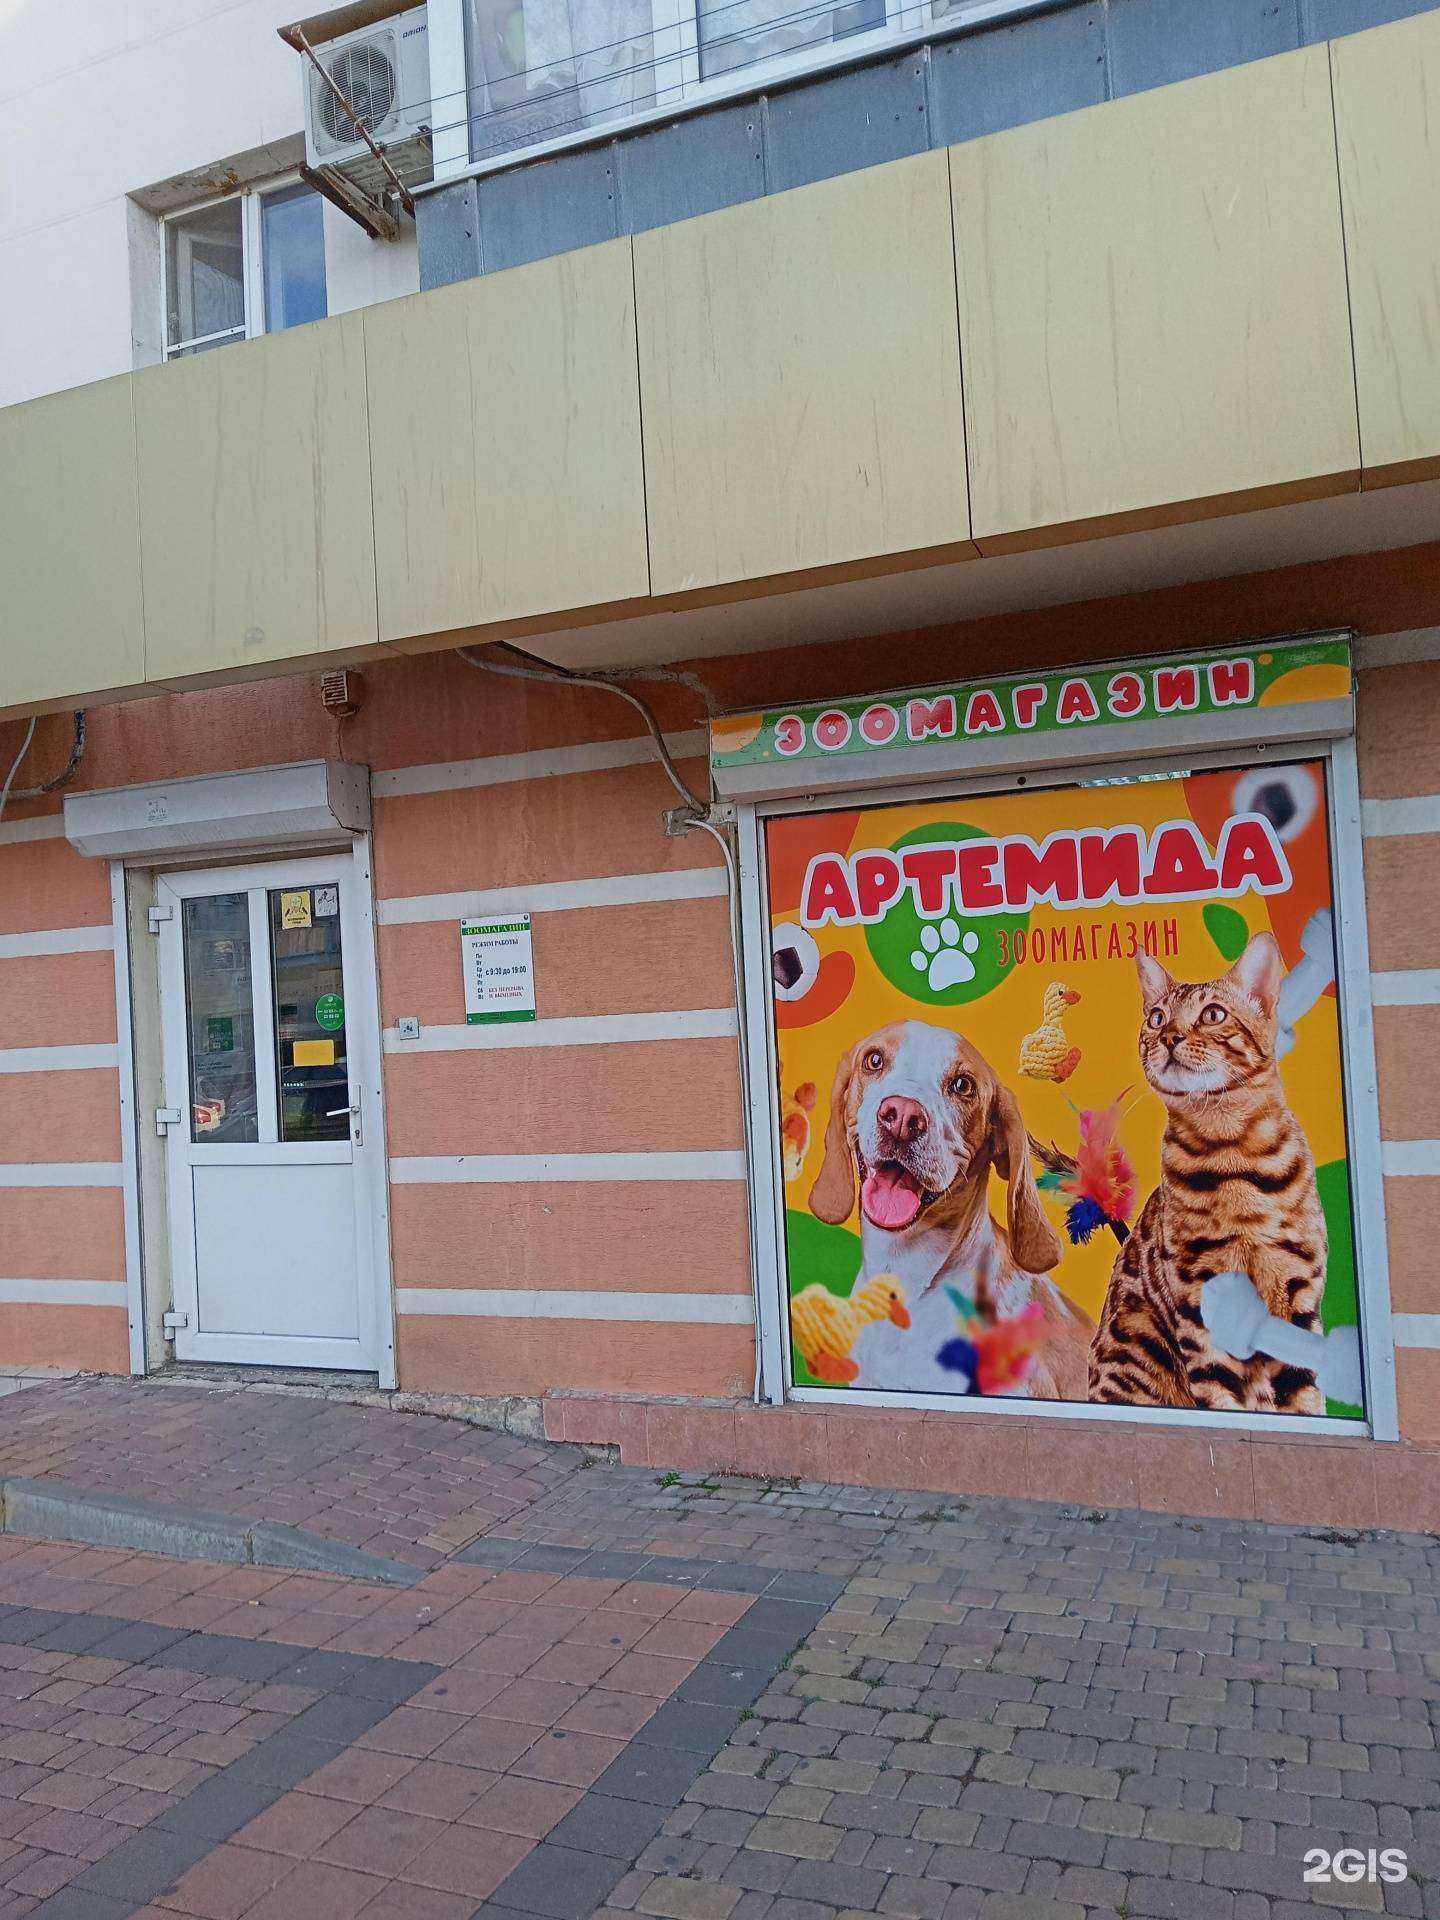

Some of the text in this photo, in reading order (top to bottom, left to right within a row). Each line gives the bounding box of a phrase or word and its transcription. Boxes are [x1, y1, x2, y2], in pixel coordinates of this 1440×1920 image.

[775, 657, 1255, 756] ЗООМАГАЗИН
[800, 811, 1294, 929] АРТЕМИДА
[466, 924, 526, 935] ЗООМАГАЗИН
[494, 938, 519, 947] РАБОТЫ
[997, 918, 1179, 966] ЗООМАГАЗИН
[502, 968, 511, 976] до
